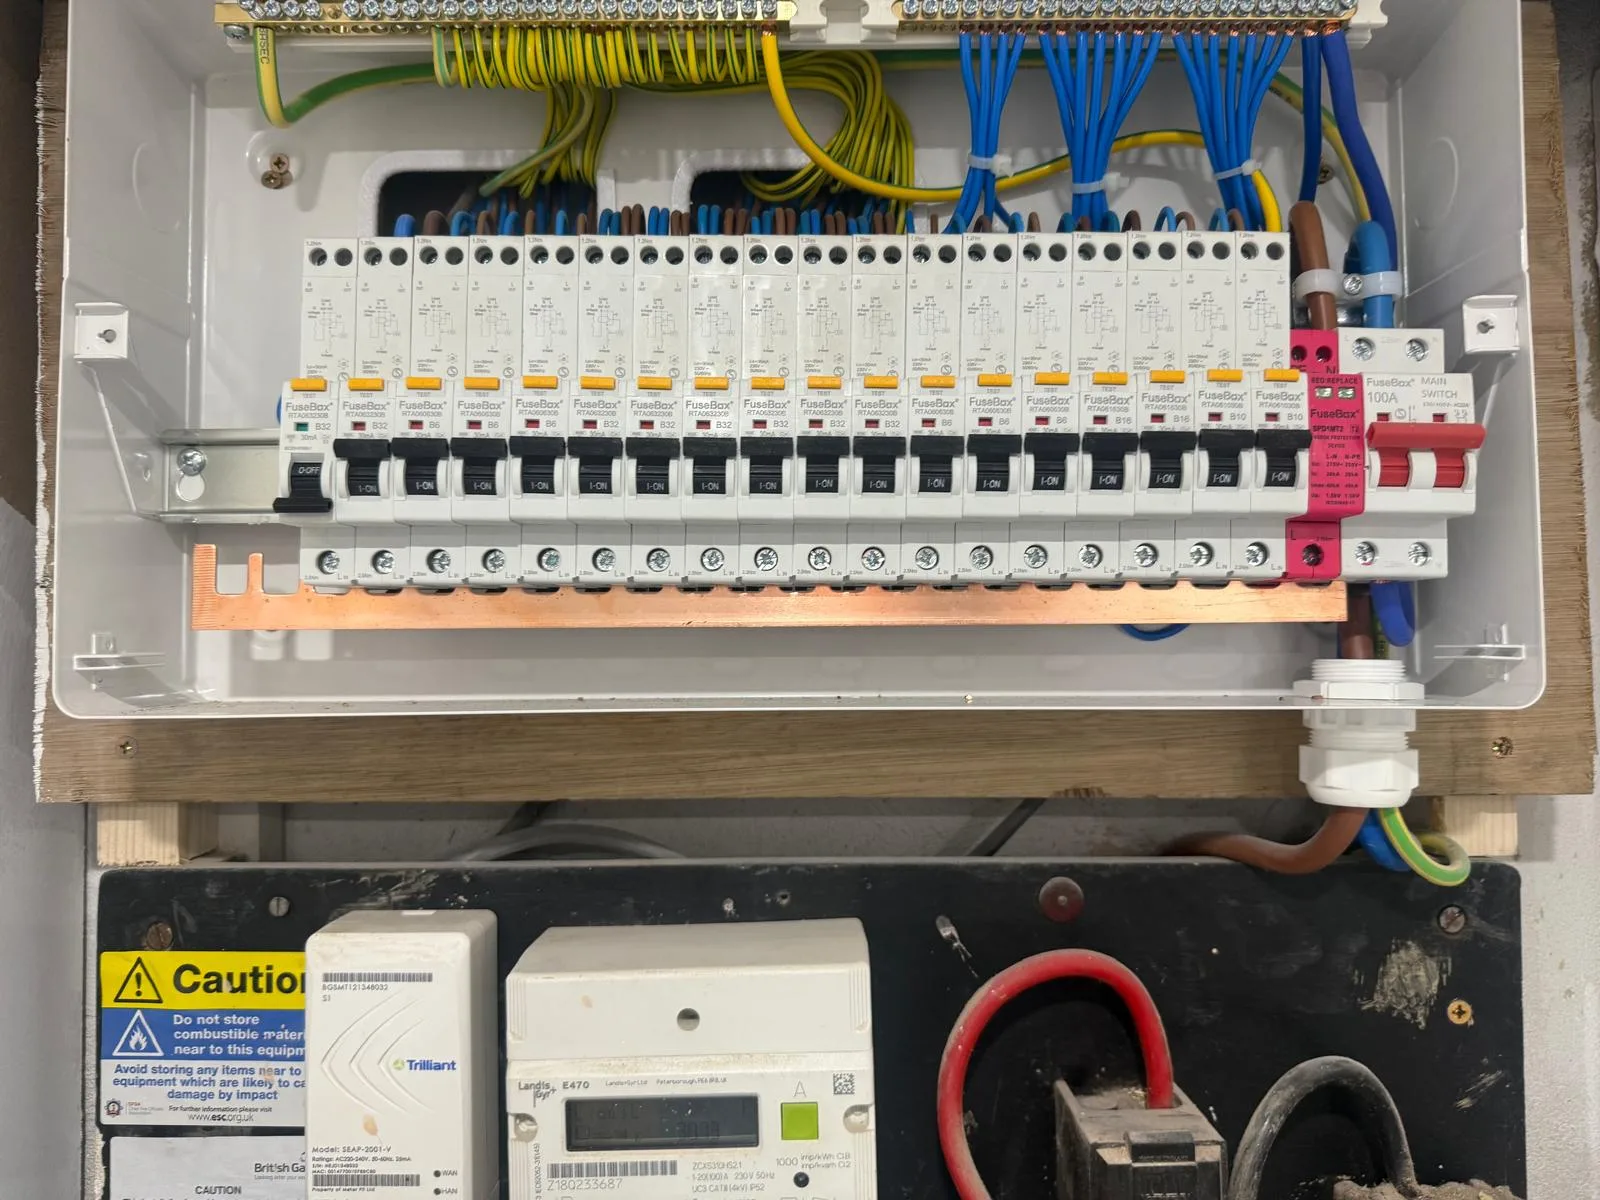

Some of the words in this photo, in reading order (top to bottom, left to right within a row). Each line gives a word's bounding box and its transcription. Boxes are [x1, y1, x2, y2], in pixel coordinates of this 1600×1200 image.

[1421, 377, 1446, 385] MAIN
[1368, 392, 1398, 403] 100A
[1422, 390, 1458, 398] SWITCH
[1173, 415, 1190, 423] B16
[315, 423, 331, 431] B32
[372, 422, 388, 430] B32
[429, 421, 440, 429] B6
[488, 421, 499, 429] B6
[603, 420, 619, 428] B32
[660, 421, 676, 429] B32
[716, 421, 732, 429] B32
[773, 420, 789, 428] B32
[885, 420, 900, 428] B32
[173, 963, 305, 994] Cautio
[173, 1014, 193, 1025] Do
[197, 1014, 221, 1025] not
[223, 1015, 260, 1025] store
[174, 1028, 259, 1039] combustible
[263, 1028, 305, 1040] mater
[174, 1046, 204, 1055] near
[209, 1045, 223, 1055] to
[227, 1044, 253, 1055] this
[406, 1060, 457, 1071] Trilliant
[114, 1064, 147, 1074] Avoid
[151, 1064, 193, 1077] storing
[197, 1066, 217, 1077] any
[222, 1065, 255, 1075] items
[258, 1066, 286, 1076] near
[289, 1066, 301, 1076] to
[112, 1078, 177, 1088] equipment
[180, 1077, 216, 1087] which
[219, 1079, 239, 1088] are
[242, 1077, 273, 1090] likely
[278, 1078, 290, 1088] to
[518, 1081, 551, 1090] Landis
[562, 1081, 590, 1089] E470
[793, 1080, 807, 1097] A
[167, 1090, 214, 1101] damage
[218, 1090, 233, 1101] by
[236, 1090, 278, 1101] impact
[239, 1106, 259, 1114] please
[188, 1113, 254, 1123] www.esc.org.uk
[776, 1157, 798, 1166] 1000
[254, 1163, 290, 1173] British
[195, 1185, 242, 1195] CAUTION
[749, 1183, 765, 1192] IP52
